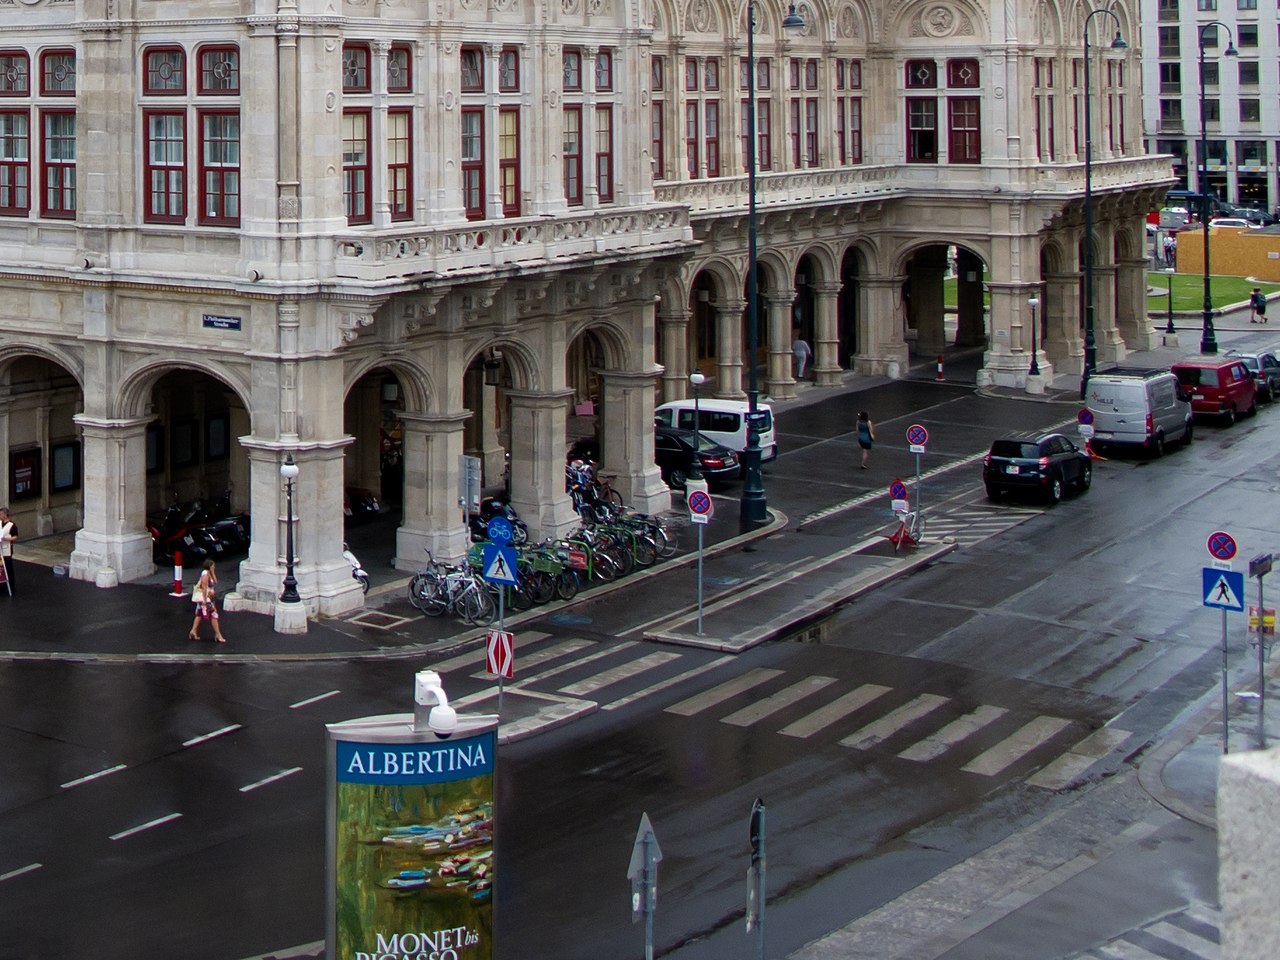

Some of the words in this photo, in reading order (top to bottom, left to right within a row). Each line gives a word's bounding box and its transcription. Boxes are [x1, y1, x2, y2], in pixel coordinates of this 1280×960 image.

[347, 743, 486, 775] ALBERTINA
[376, 926, 466, 954] MONET
[465, 929, 480, 946] bis
